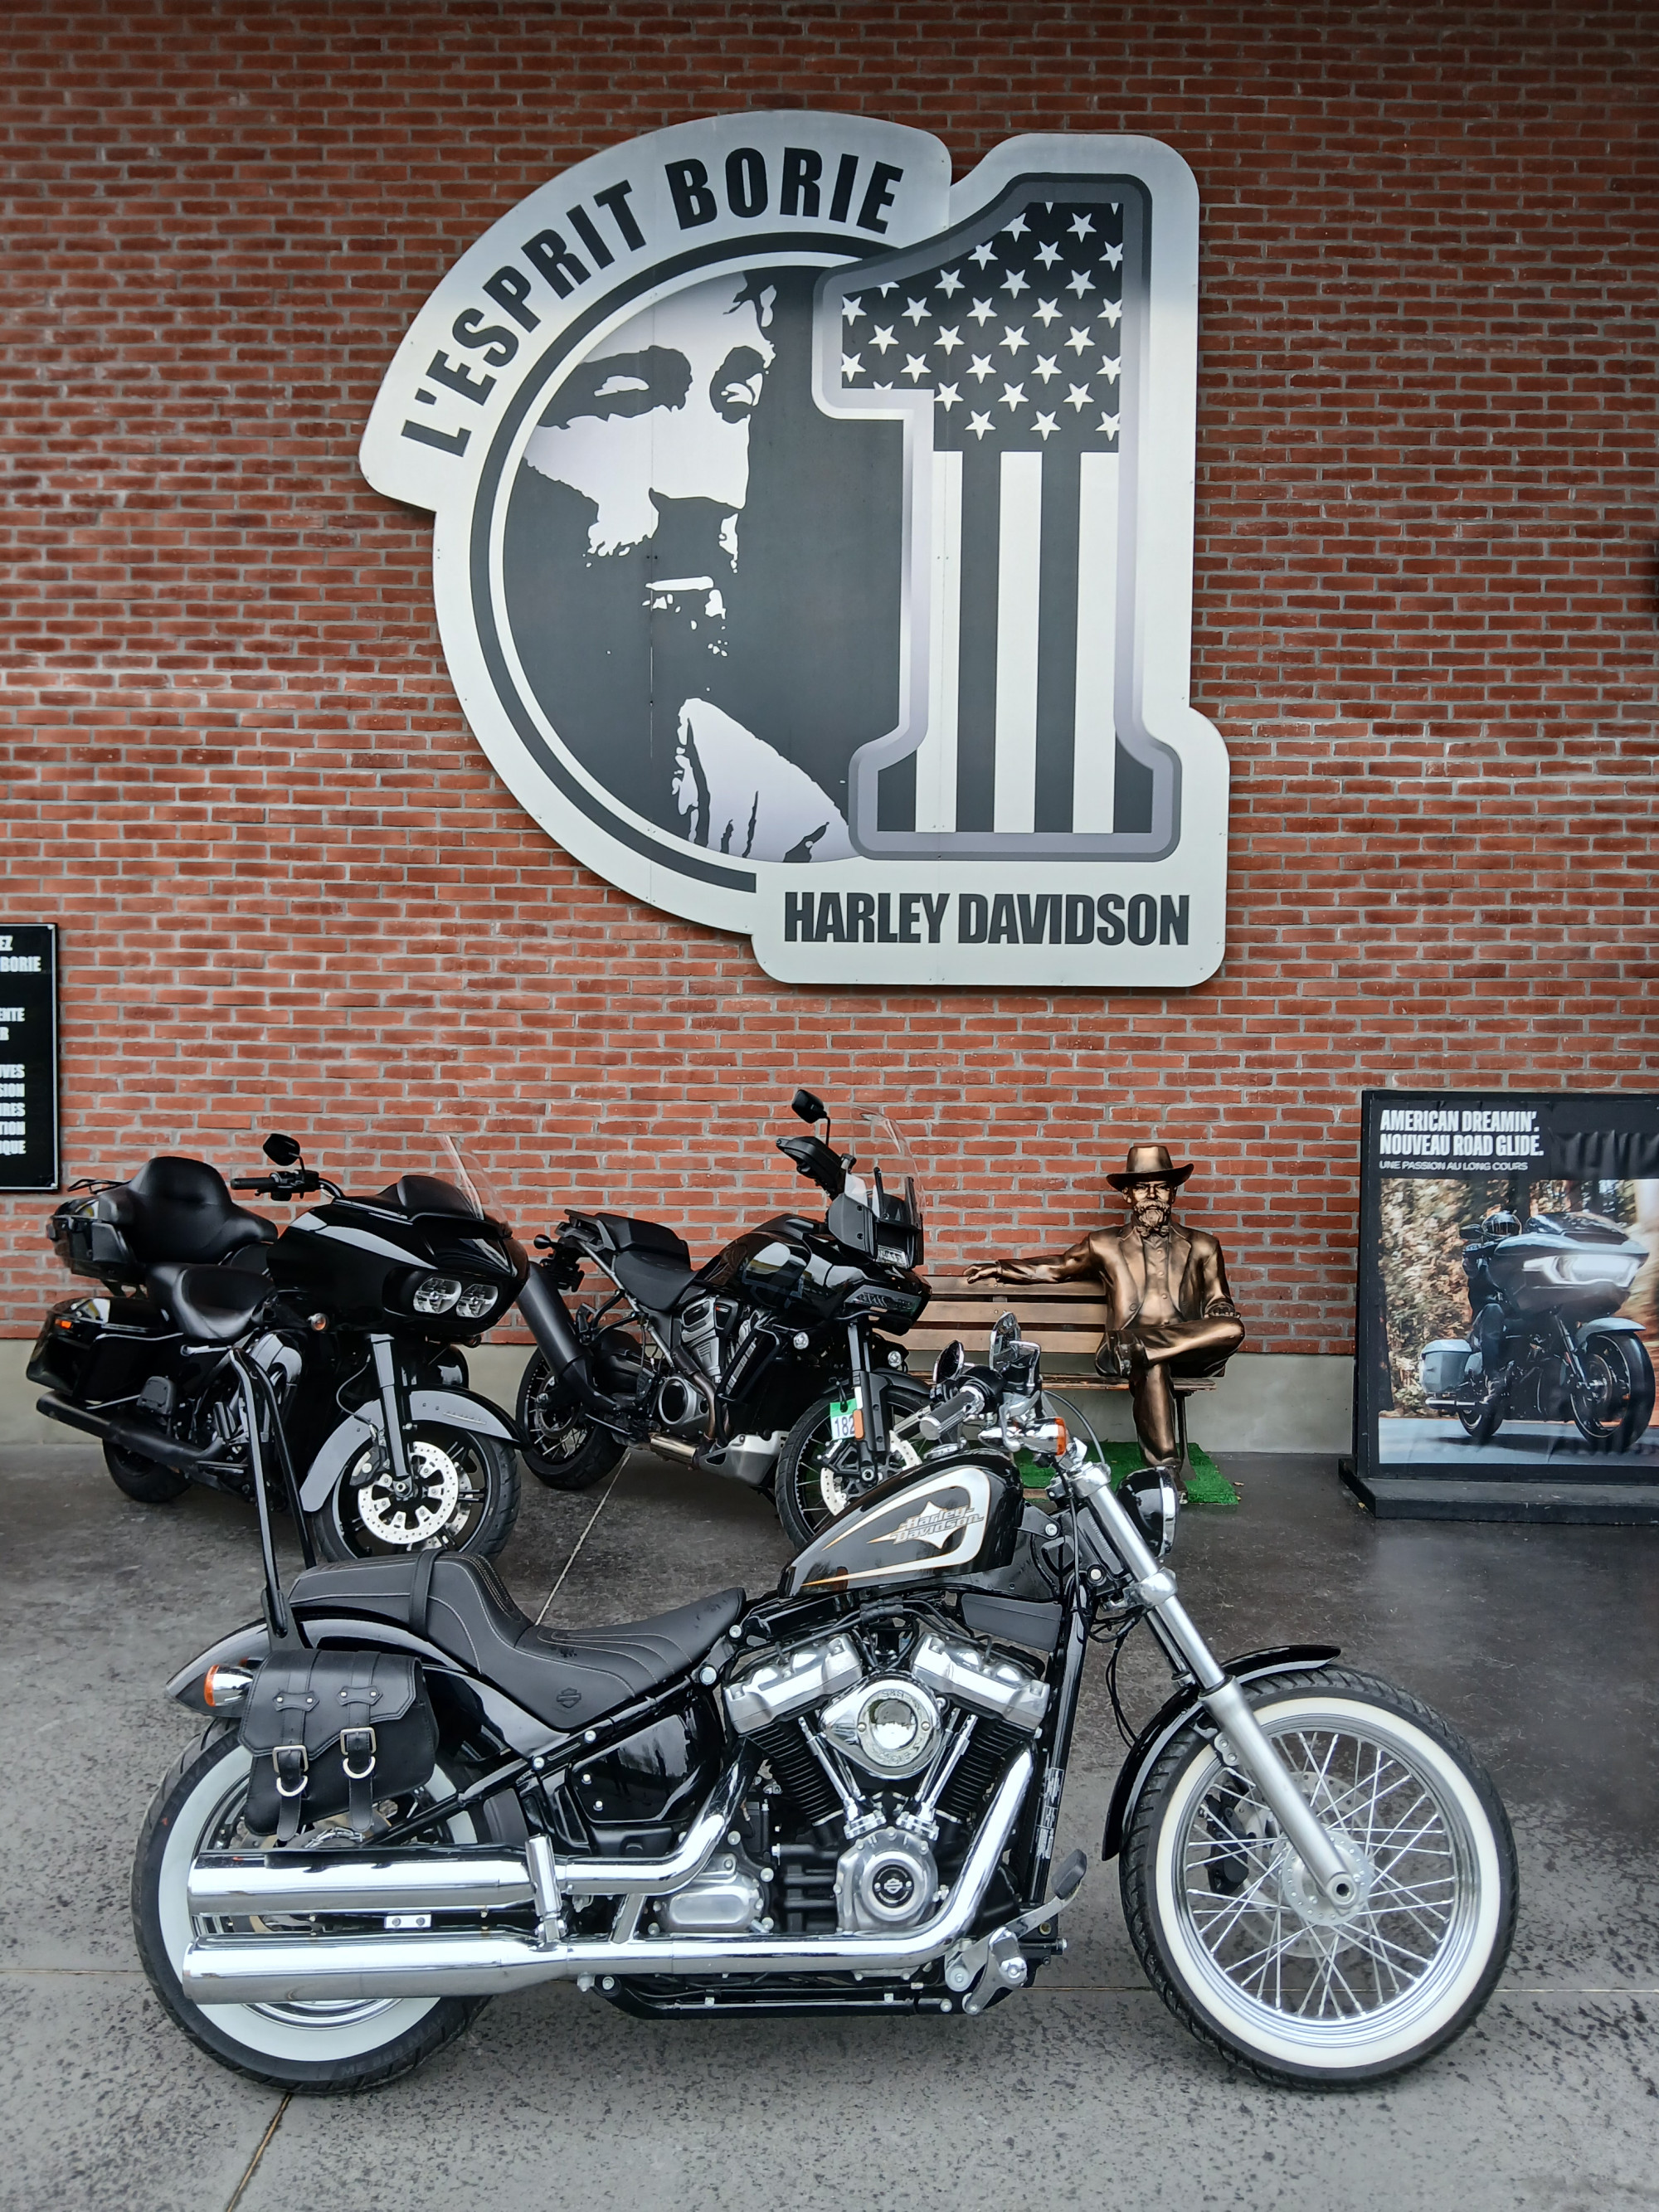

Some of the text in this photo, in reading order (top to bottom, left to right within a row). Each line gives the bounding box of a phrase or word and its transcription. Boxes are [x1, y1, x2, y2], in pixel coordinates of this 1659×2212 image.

[401, 147, 904, 457] L'ESPRIT BORIE
[784, 892, 1190, 946] HARLEY DAVIDSON
[1379, 1109, 1460, 1131] AMERICAN
[1379, 1133, 1545, 1156] NOUVEAU ROAD GLIDE.
[1379, 1160, 1529, 1171] UNE PASSION AU LONG COURS
